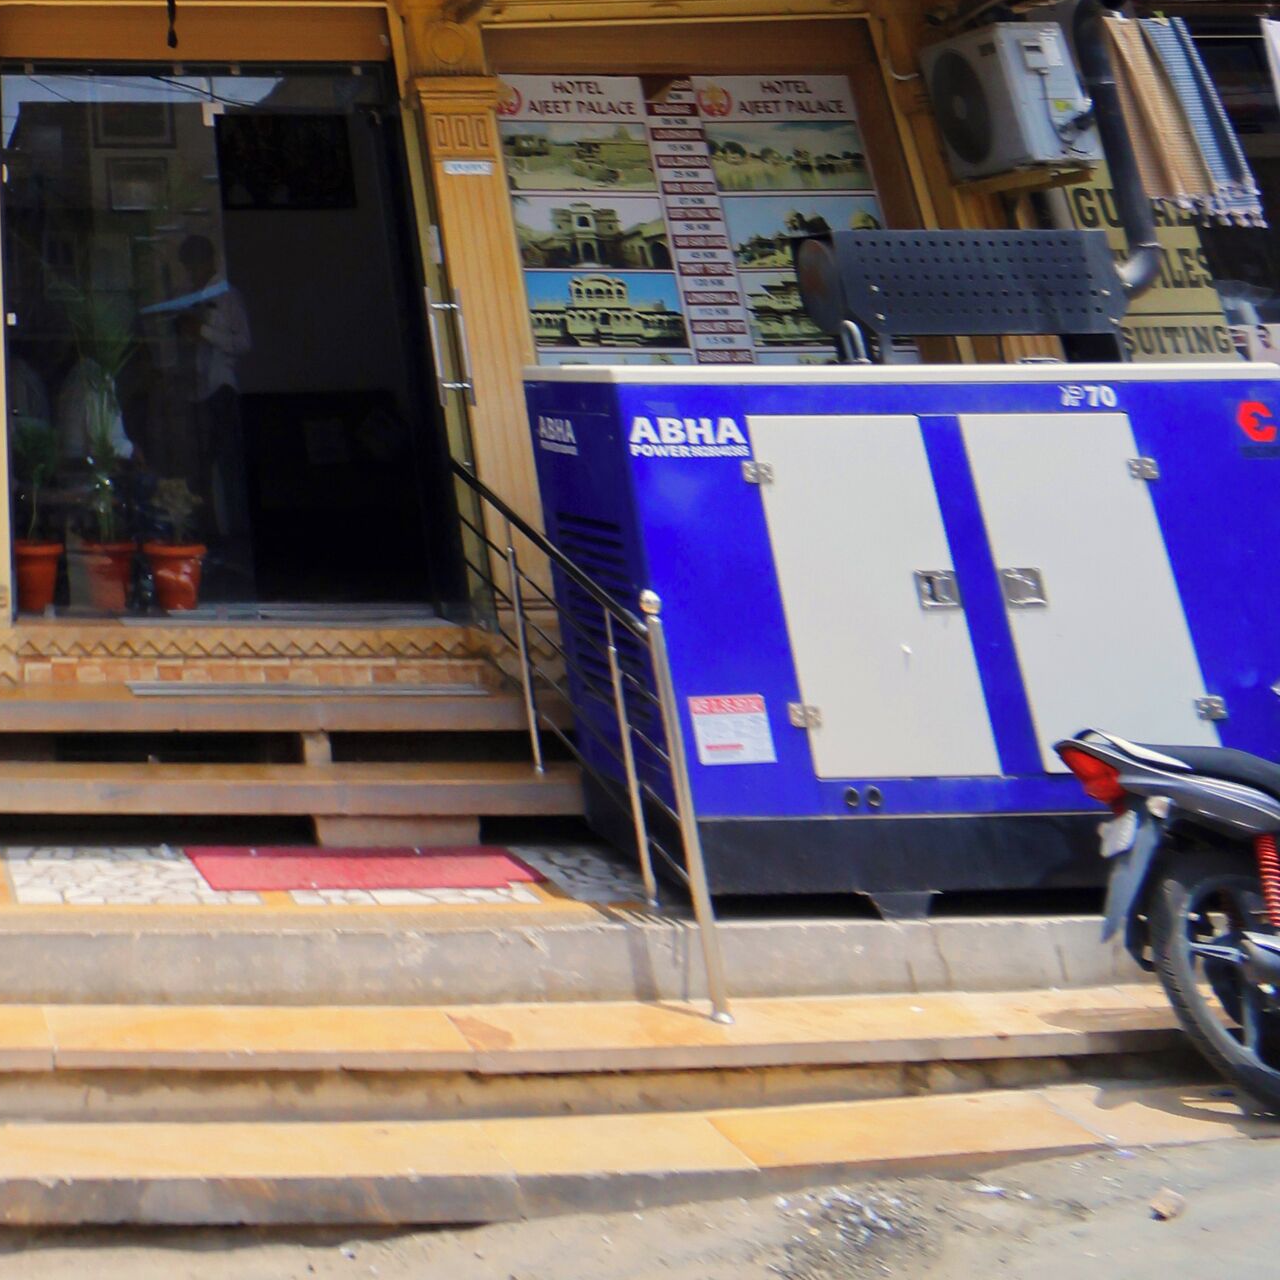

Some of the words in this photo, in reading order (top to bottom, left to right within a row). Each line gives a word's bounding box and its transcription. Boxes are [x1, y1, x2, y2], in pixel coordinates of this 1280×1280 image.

[551, 80, 604, 96] HOTEL
[761, 80, 813, 96] HOTEL
[528, 101, 573, 117] AJEET
[577, 101, 637, 116] PALACE
[738, 101, 783, 117] AJEET
[787, 101, 847, 115] PALACE
[629, 416, 747, 444] ABHA
